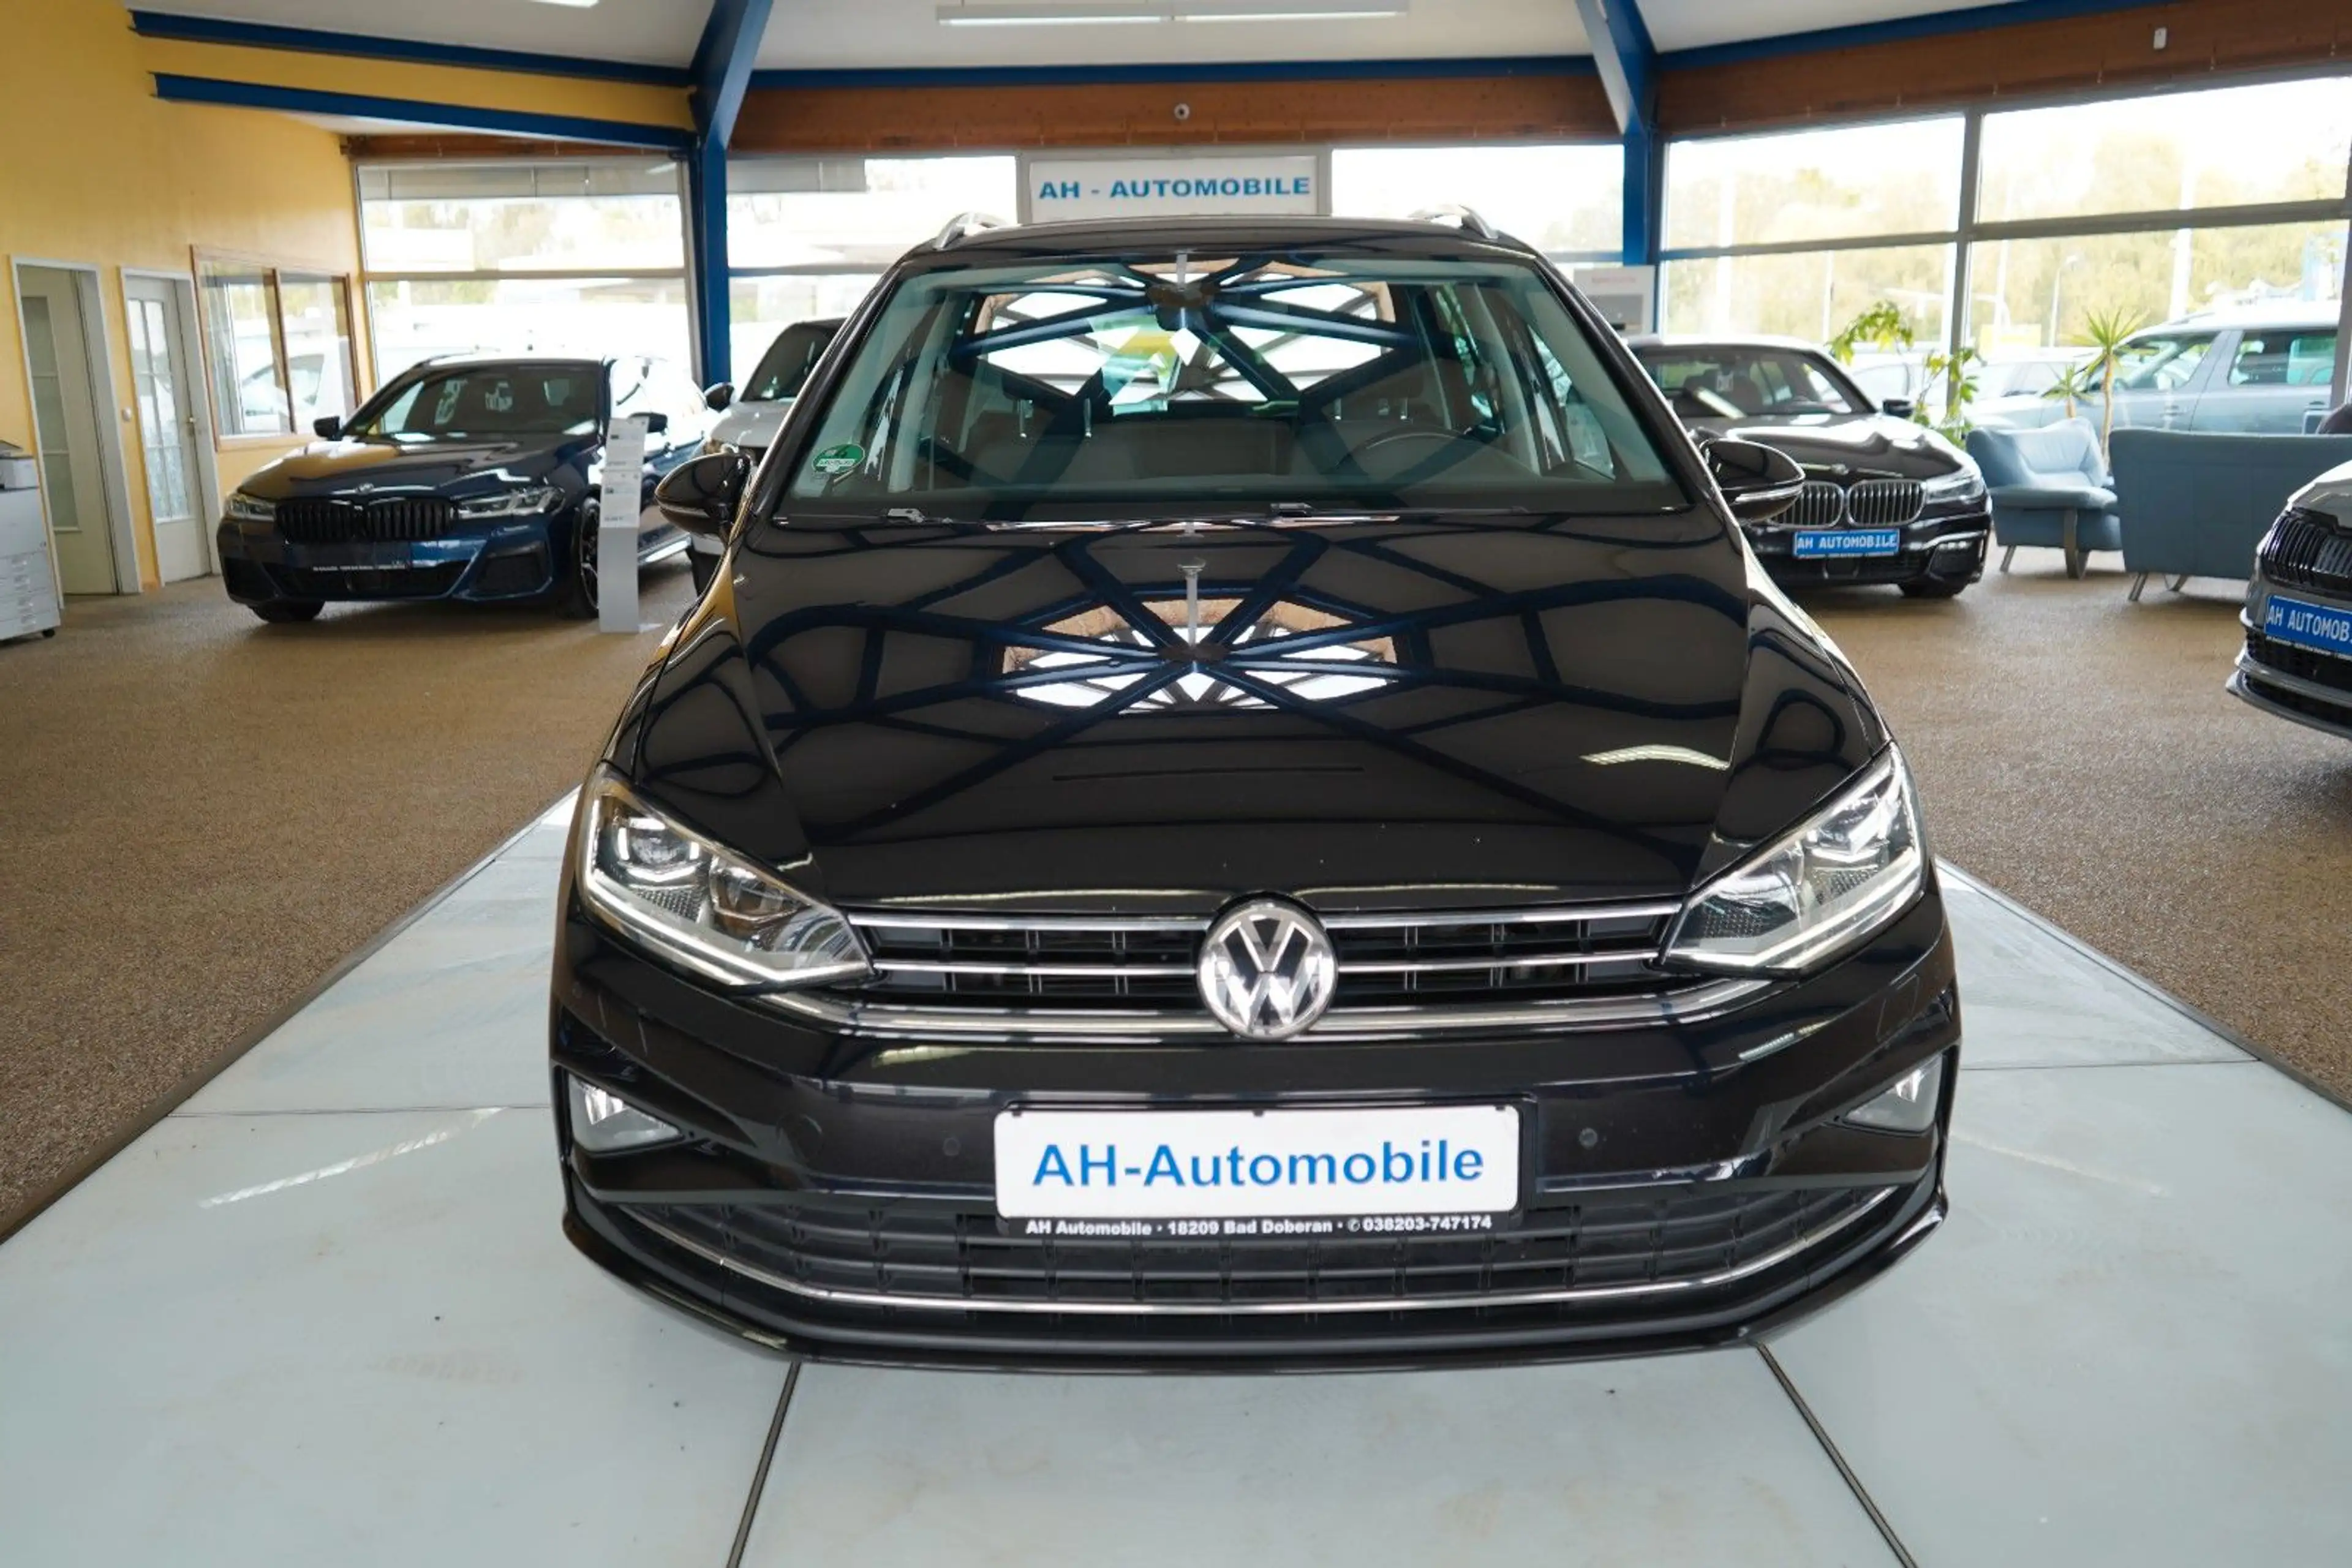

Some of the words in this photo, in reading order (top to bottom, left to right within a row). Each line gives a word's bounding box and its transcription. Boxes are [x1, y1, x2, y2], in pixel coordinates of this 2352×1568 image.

[1039, 181, 1080, 199] AH
[1109, 177, 1311, 198] AUTOMOBILE
[1797, 537, 1814, 549] AH
[1819, 533, 1898, 549] AUTOMOBILE
[2266, 605, 2284, 627] AH
[2287, 609, 2352, 646] AUTOMOB
[1032, 1140, 1485, 1187] AH-Automobile
[1026, 1219, 1052, 1235] AH
[1056, 1219, 1152, 1236] Automobile
[1167, 1219, 1219, 1235] 18209
[1224, 1219, 1257, 1234] Bad
[1262, 1218, 1333, 1234] Doberan
